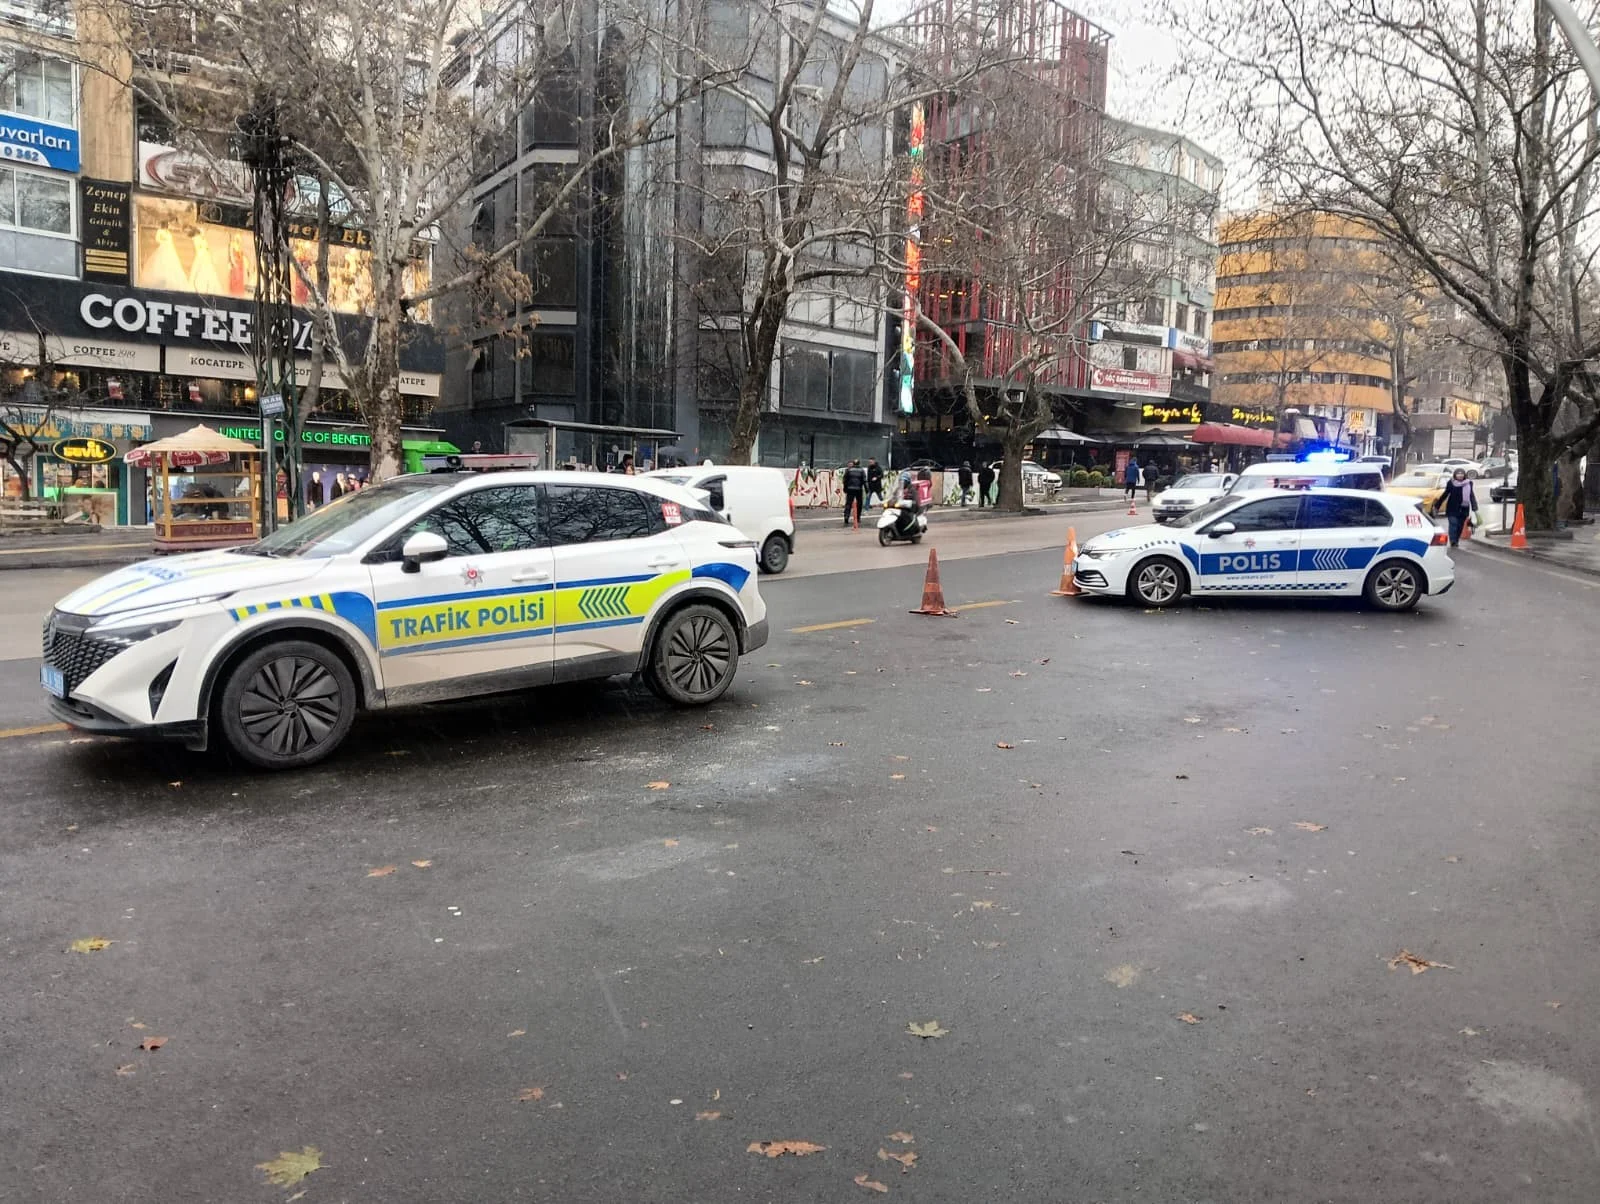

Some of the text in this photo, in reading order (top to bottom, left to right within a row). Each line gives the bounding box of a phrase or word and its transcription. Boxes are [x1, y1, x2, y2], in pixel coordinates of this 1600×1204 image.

[86, 186, 127, 202] Zeynep
[93, 203, 120, 215] Ekin
[79, 293, 253, 344] COFFEE
[73, 345, 117, 357] COFFEE
[190, 356, 245, 369] KOCATEPE
[219, 426, 261, 441] UNITED
[314, 431, 333, 443] OF
[390, 597, 545, 639] TRAFİK POLİSİ
